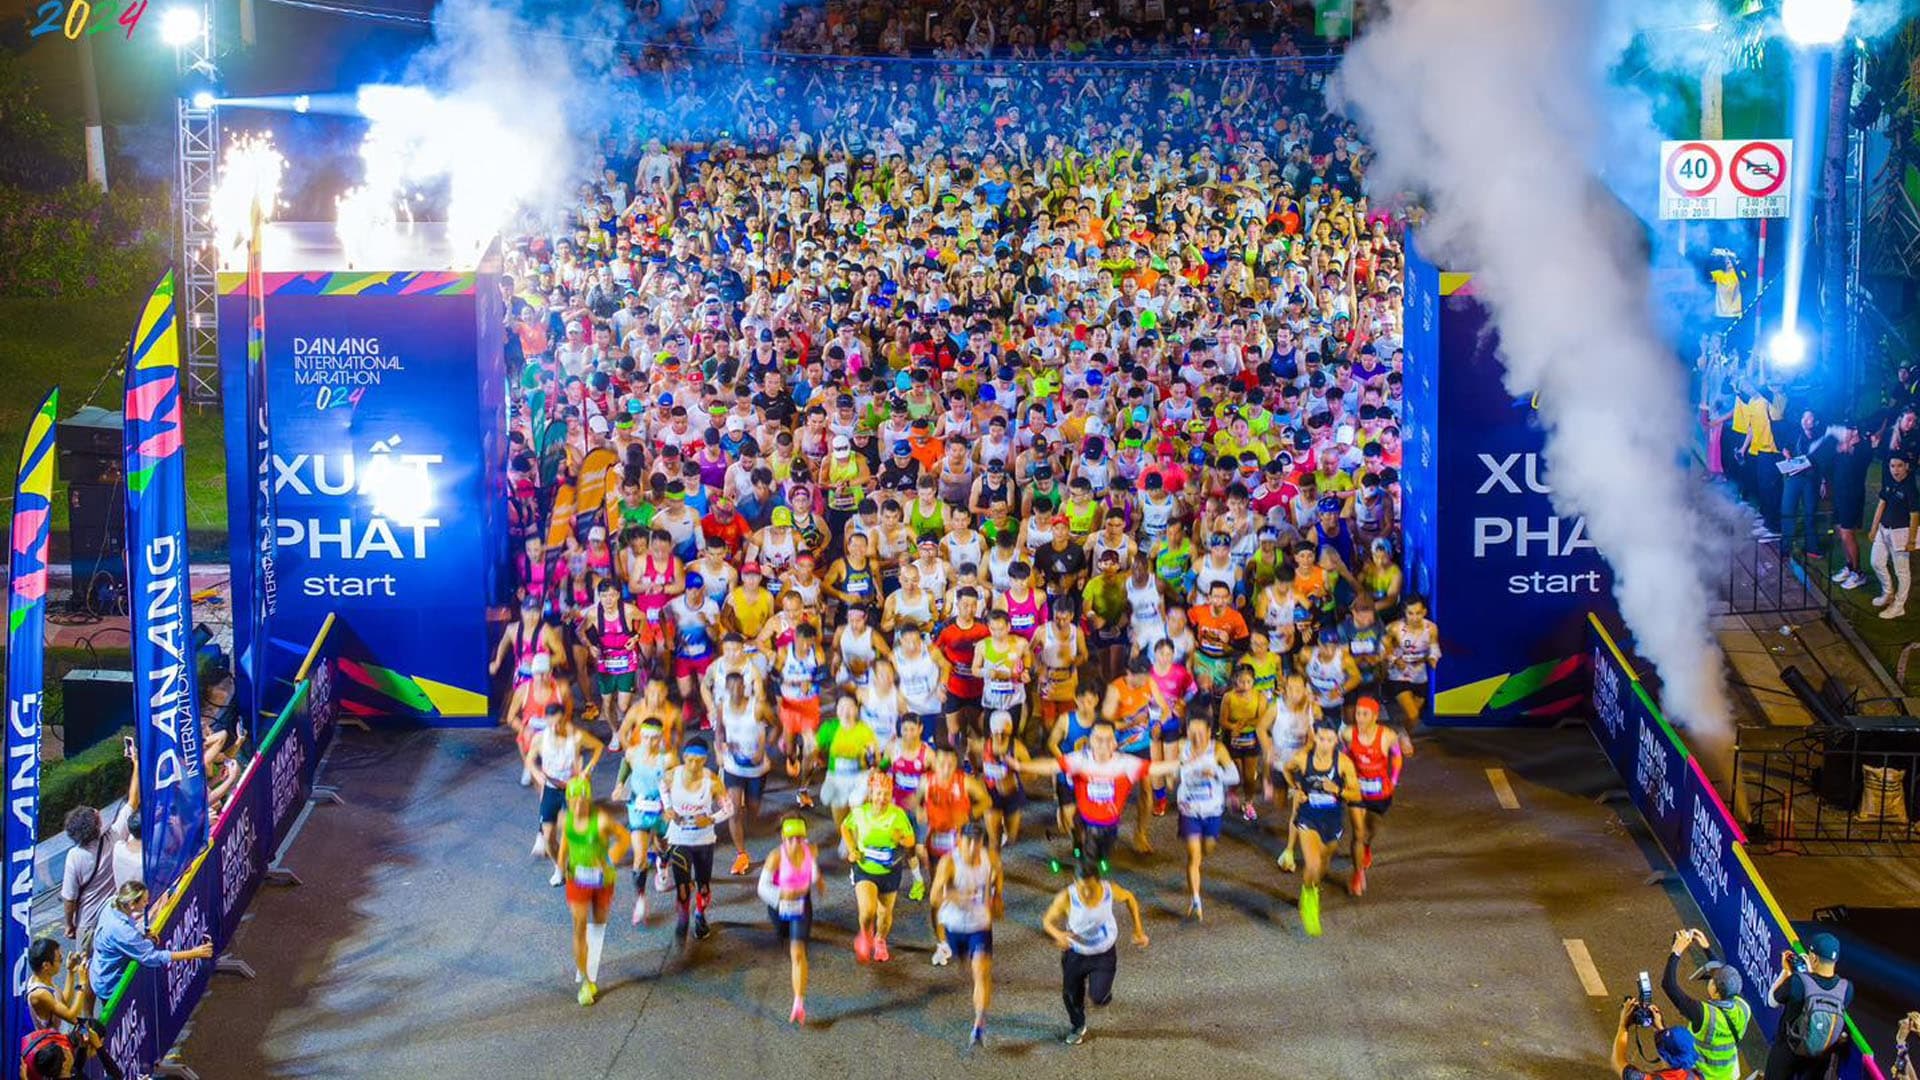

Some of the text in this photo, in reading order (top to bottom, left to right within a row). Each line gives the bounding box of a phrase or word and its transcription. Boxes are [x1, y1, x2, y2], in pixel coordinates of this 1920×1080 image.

[1680, 158, 1707, 178] 40
[294, 338, 379, 354] DANANG
[294, 356, 404, 369] INTERNATIONAL
[295, 371, 380, 384] MARATHON
[304, 574, 396, 596] start
[1508, 571, 1600, 593] start
[146, 535, 182, 790] DANANG
[1693, 793, 1722, 860] DANANG
[1741, 886, 1771, 960] DANANG
